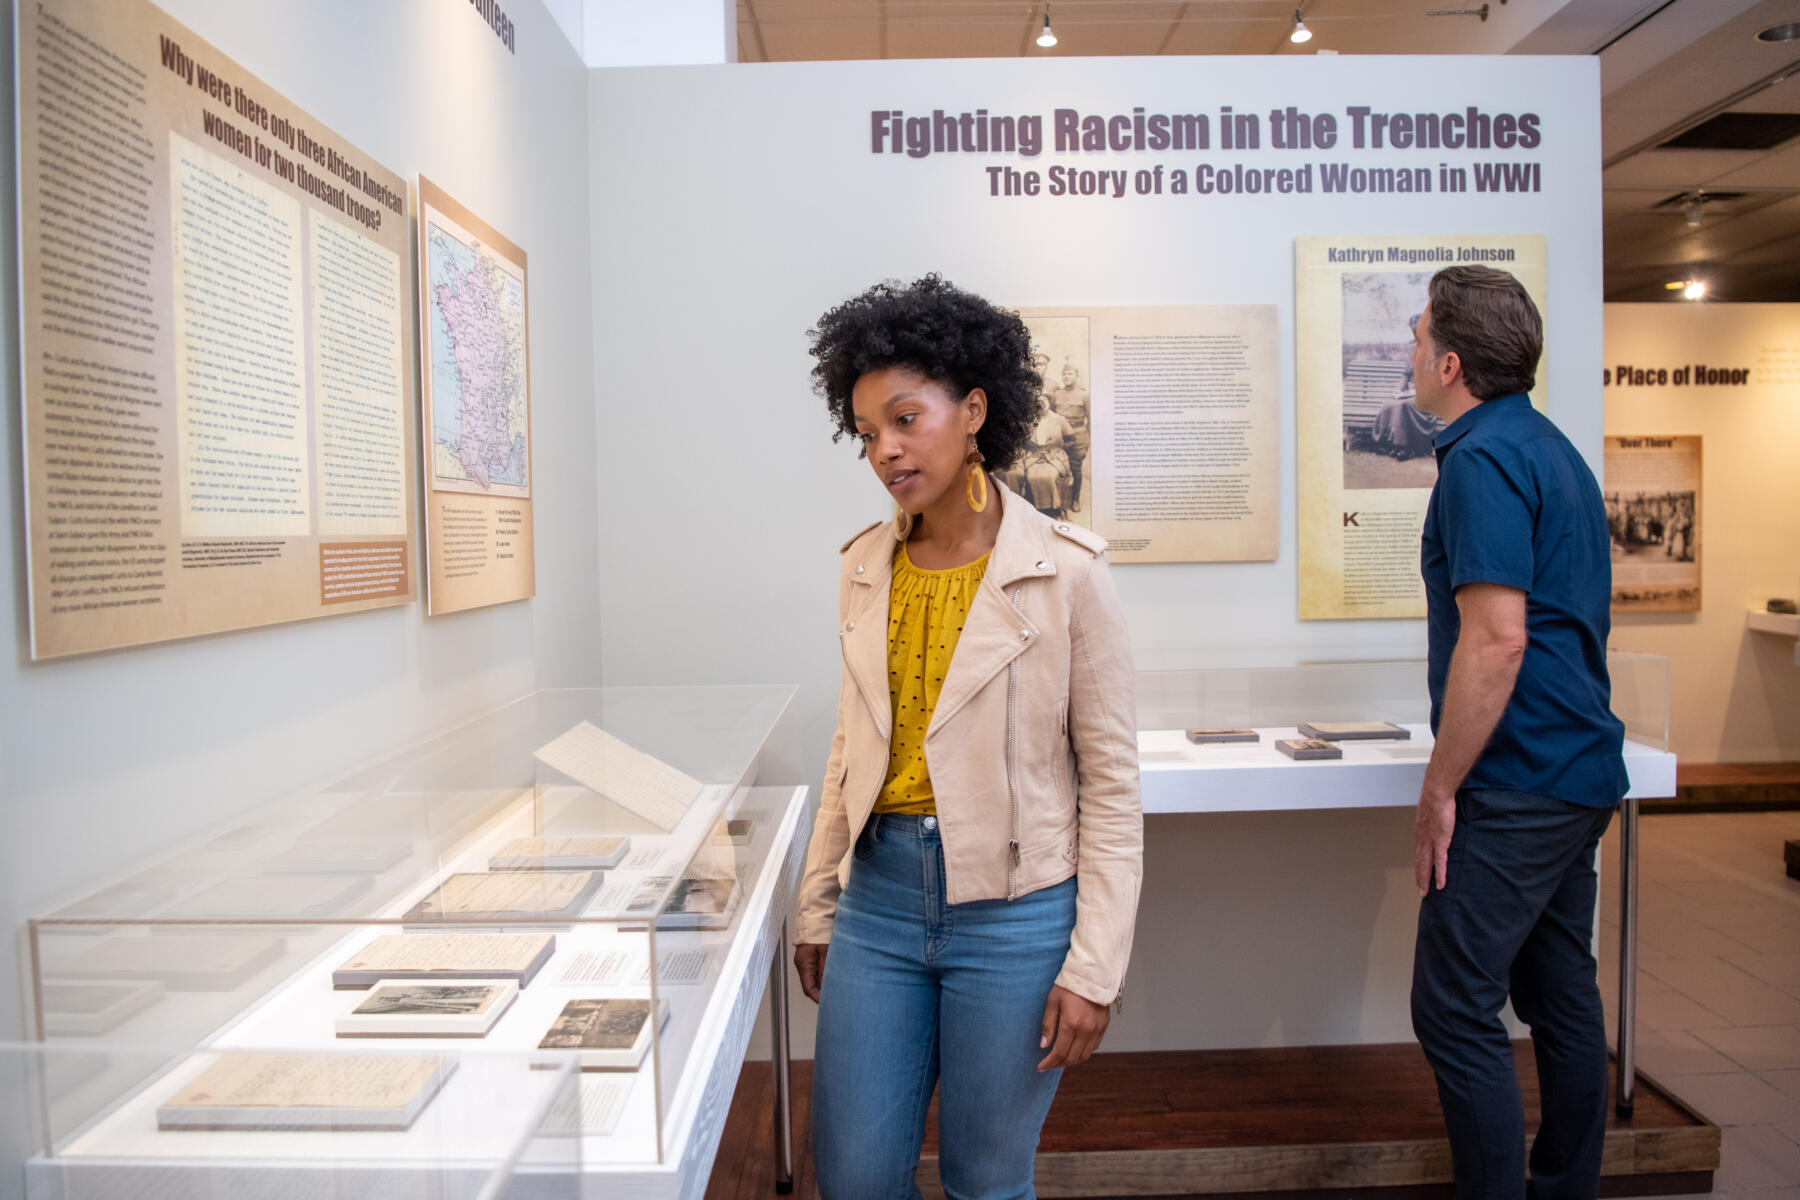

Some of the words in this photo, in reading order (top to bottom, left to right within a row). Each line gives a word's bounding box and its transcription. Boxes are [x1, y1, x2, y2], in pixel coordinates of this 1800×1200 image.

[469, 0, 514, 55] nteen
[160, 34, 194, 86] Why
[197, 63, 231, 107] were
[235, 86, 268, 131] there
[271, 114, 295, 150] only
[297, 128, 325, 167] three
[327, 147, 361, 190] African
[363, 171, 403, 216] American
[872, 109, 1042, 158] Fighting
[1054, 107, 1210, 151] Racism
[1220, 106, 1260, 149] in
[1269, 107, 1337, 149] the
[1346, 106, 1541, 149] Trenches
[203, 108, 252, 159] women
[254, 136, 272, 170] for
[274, 149, 295, 183] two
[297, 163, 345, 212] thousand
[347, 193, 381, 232] troops?
[985, 166, 1040, 196] The
[1049, 165, 1127, 198] Story
[1135, 165, 1163, 195] of
[1170, 169, 1188, 195] a
[1196, 163, 1312, 194] Colored
[1320, 163, 1432, 193] Woman
[1439, 163, 1466, 192] in
[1474, 163, 1541, 192] WWI
[1328, 247, 1384, 263] Kathryn
[1387, 246, 1453, 263] Magnolia
[1457, 246, 1515, 262] Johnson
[1616, 365, 1668, 386] Place
[1673, 364, 1690, 386] of
[1694, 364, 1750, 386] Honor
